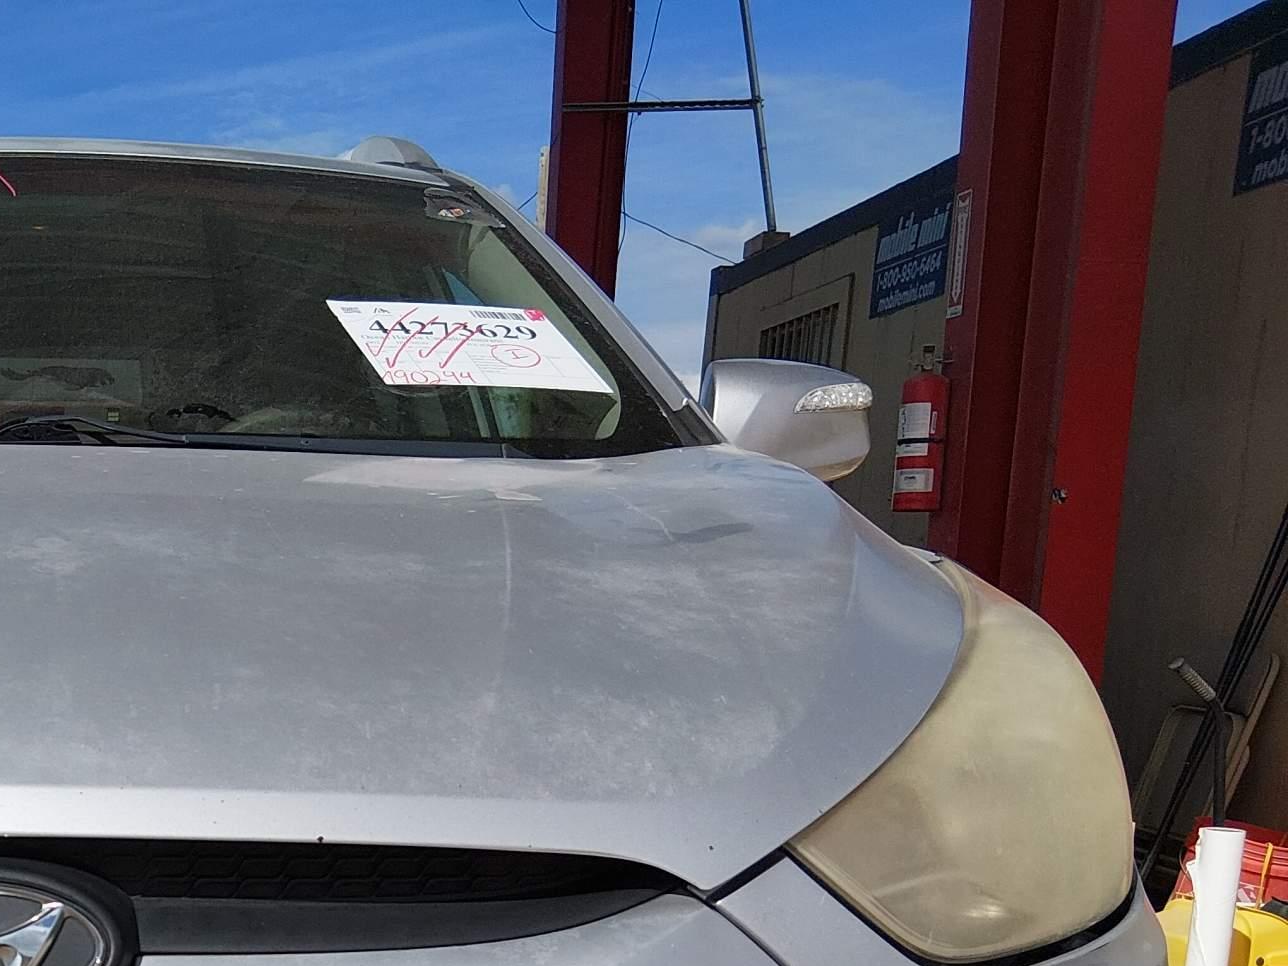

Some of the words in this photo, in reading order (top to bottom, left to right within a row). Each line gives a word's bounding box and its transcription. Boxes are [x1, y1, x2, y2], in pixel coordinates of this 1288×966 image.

[876, 211, 919, 264] mobile
[917, 202, 952, 249] mini
[368, 319, 538, 340] 44273629
